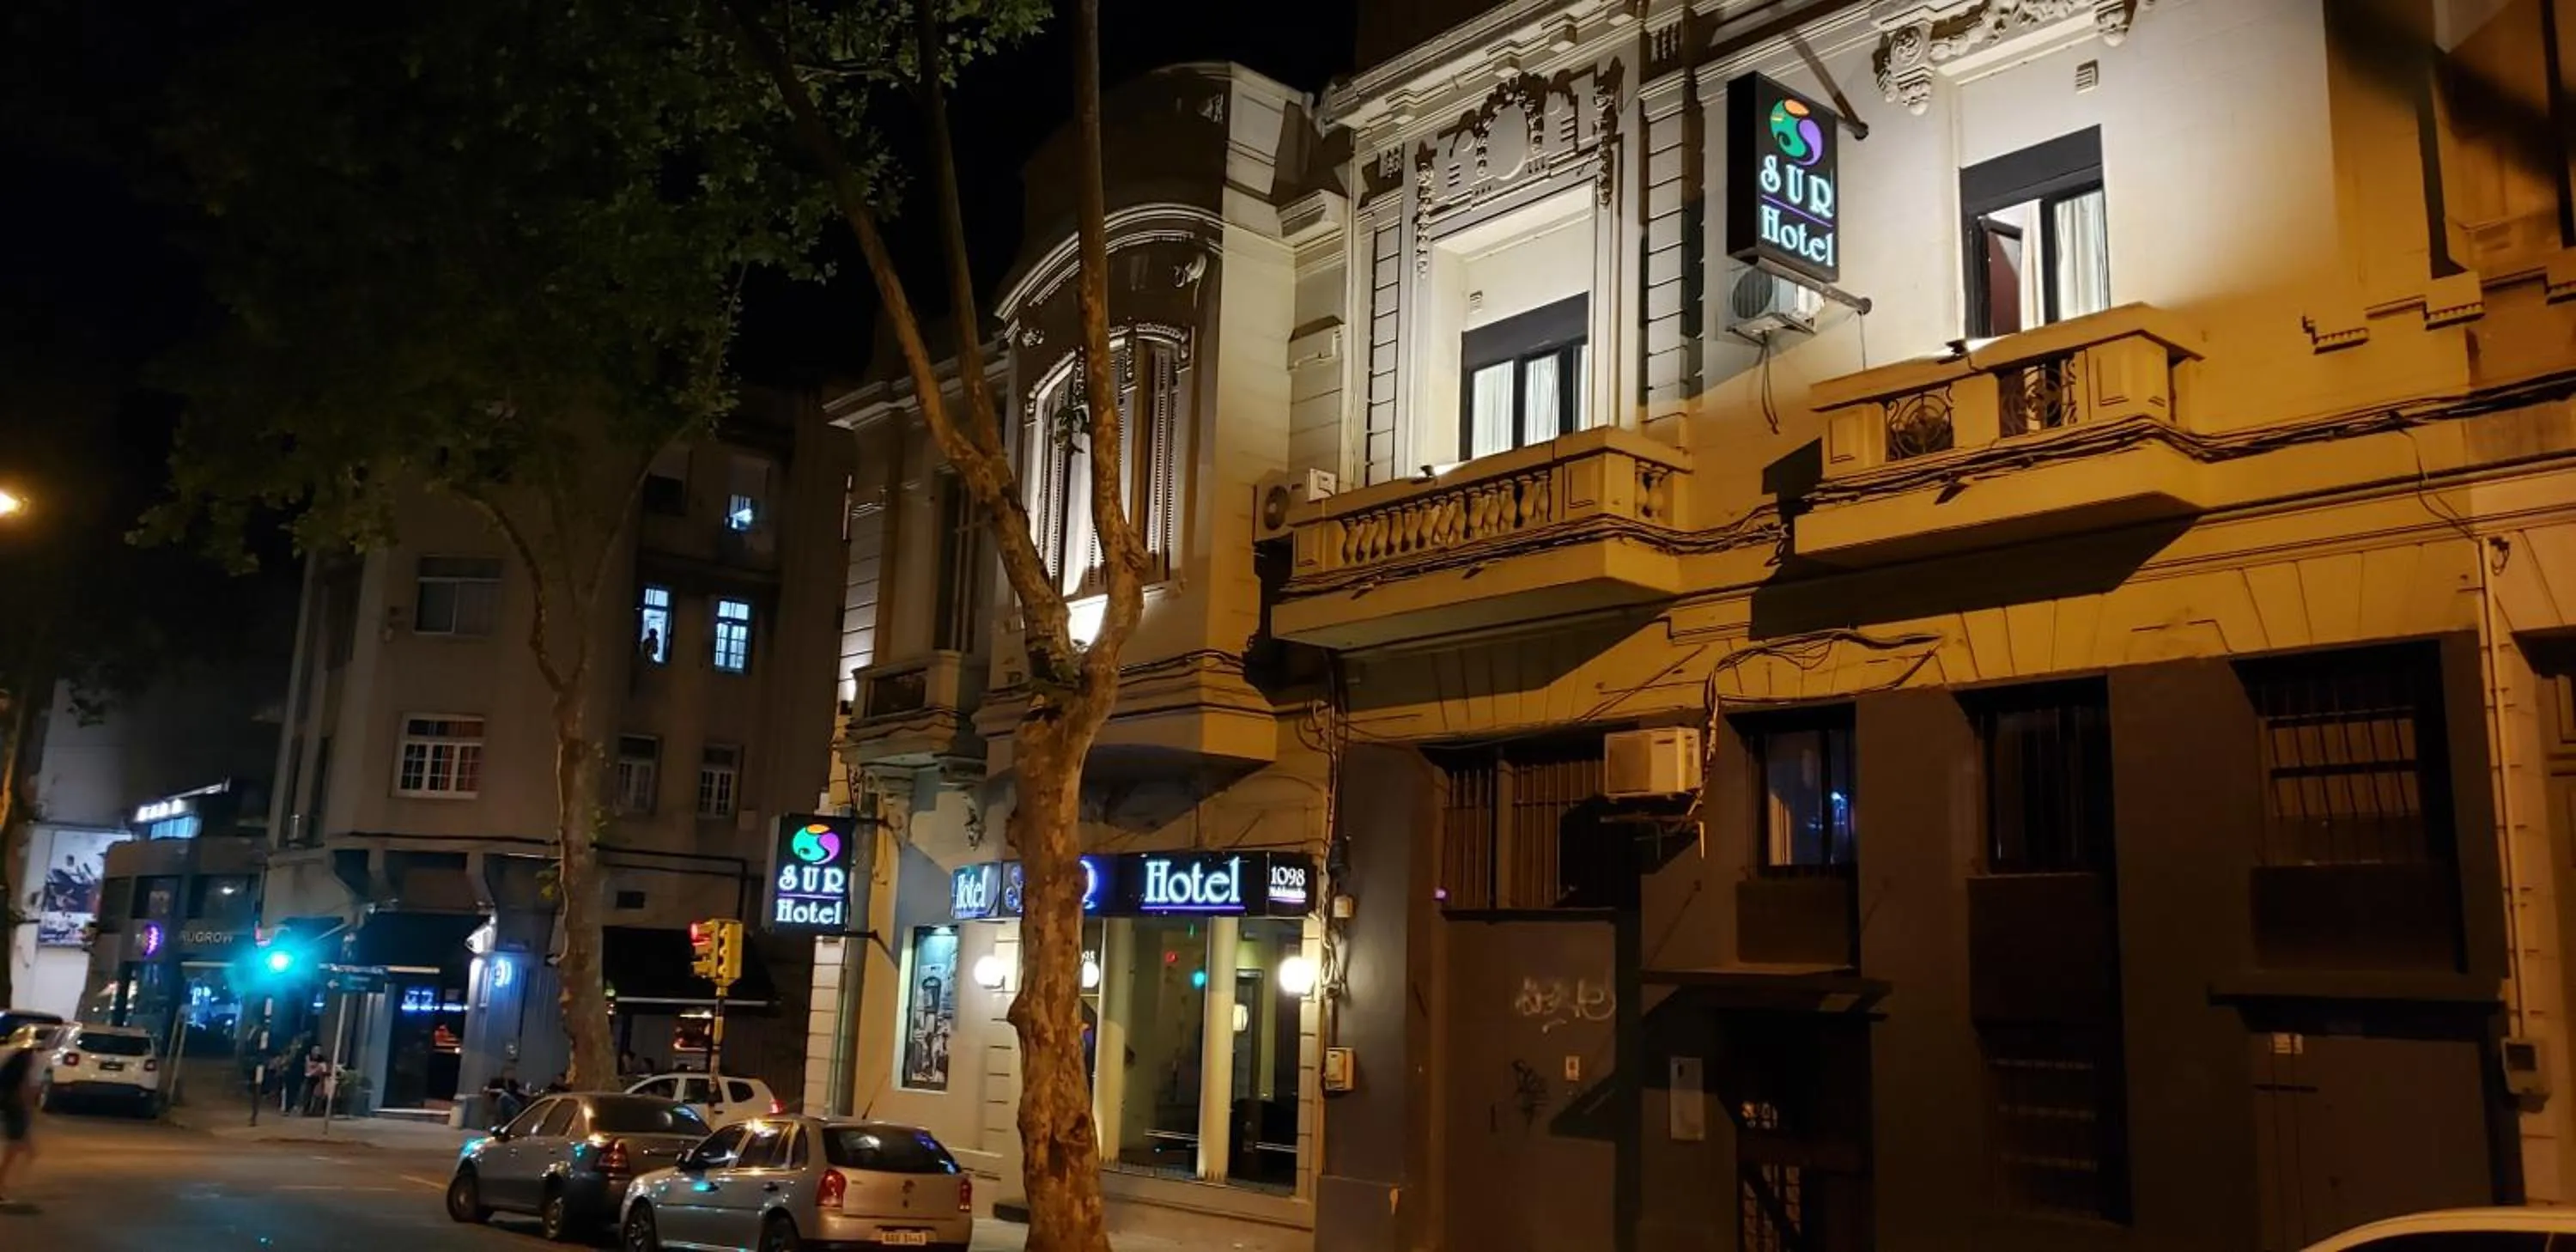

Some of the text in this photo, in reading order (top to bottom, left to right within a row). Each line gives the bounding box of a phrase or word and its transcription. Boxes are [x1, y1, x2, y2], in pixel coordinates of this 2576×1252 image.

[1760, 154, 1835, 219] SUR
[1761, 204, 1835, 267] Hotel
[778, 864, 845, 894] SUR
[956, 865, 989, 909] Hotel
[1145, 855, 1241, 903] Hotel
[1271, 866, 1306, 886] 1098
[775, 898, 843, 925] Hotel
